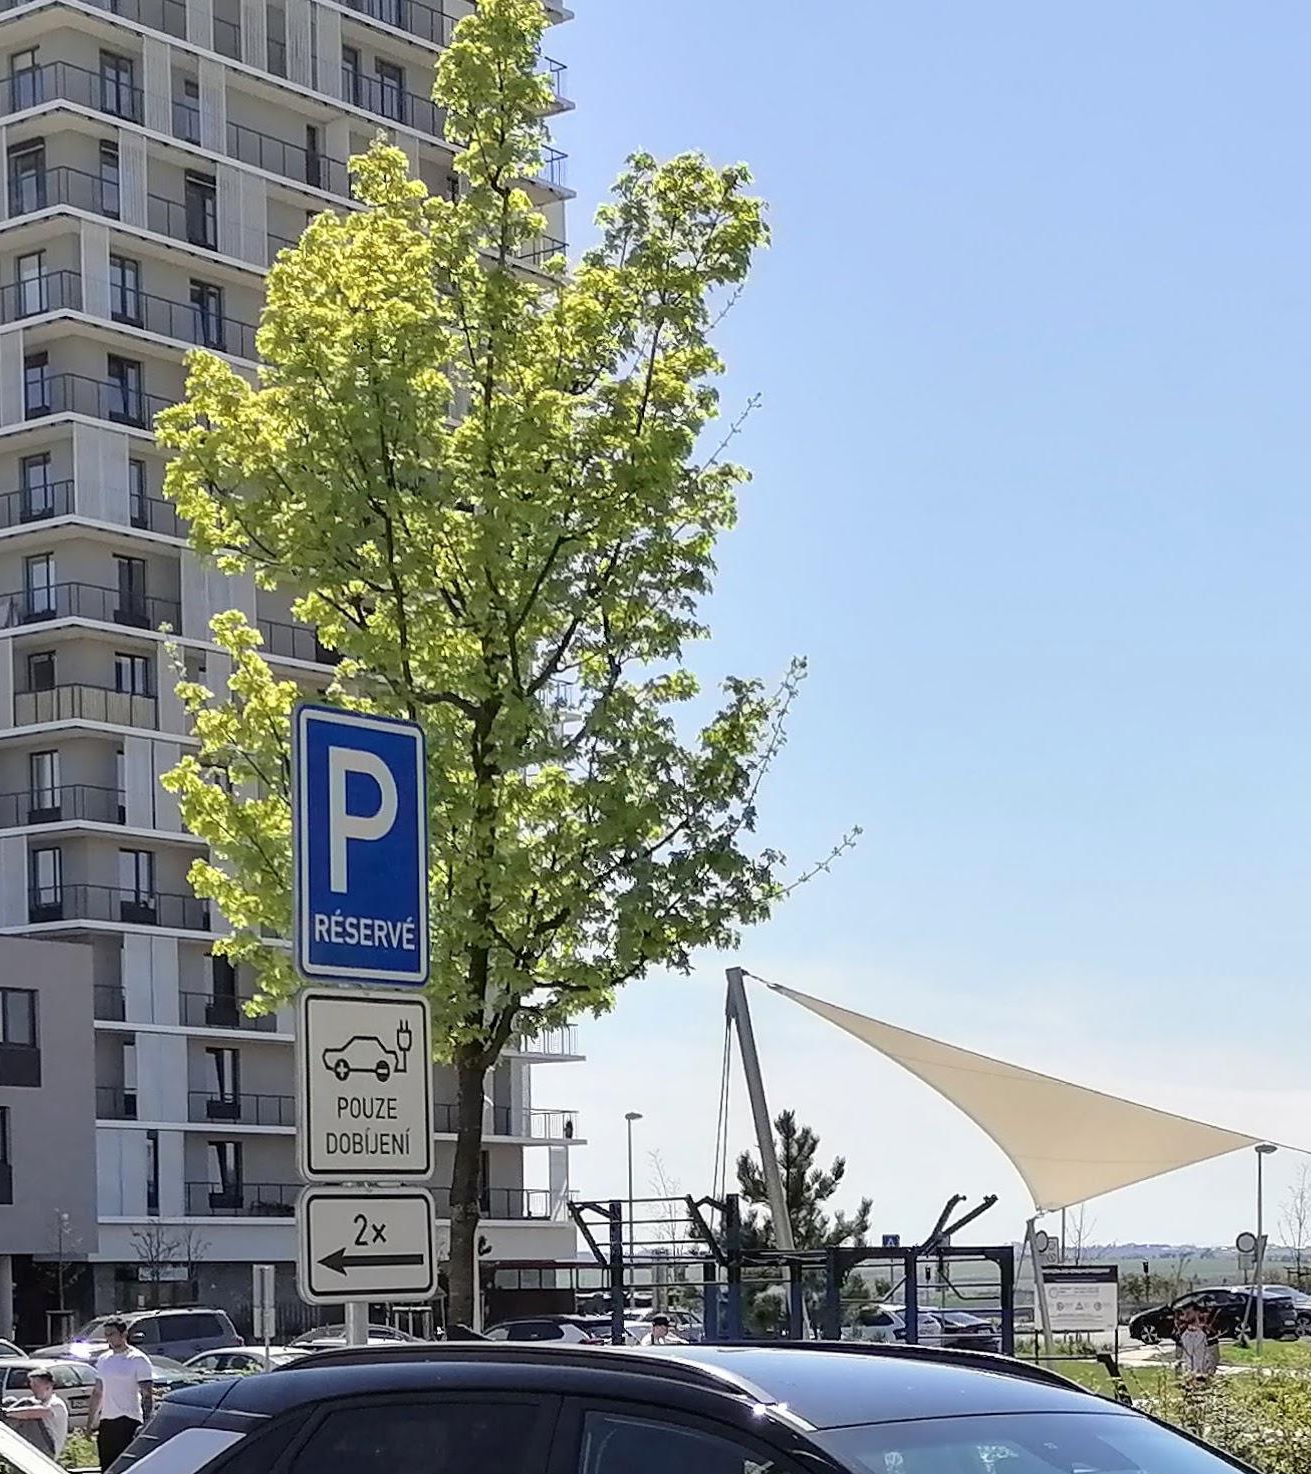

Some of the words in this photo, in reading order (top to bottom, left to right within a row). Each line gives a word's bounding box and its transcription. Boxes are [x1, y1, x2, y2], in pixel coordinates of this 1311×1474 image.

[328, 745, 398, 894] P
[314, 909, 416, 951] RÉSERVÉ
[337, 1096, 398, 1120] POUZE
[326, 1127, 410, 1156] DOBÍJENÍ
[353, 1213, 387, 1247] 2x
